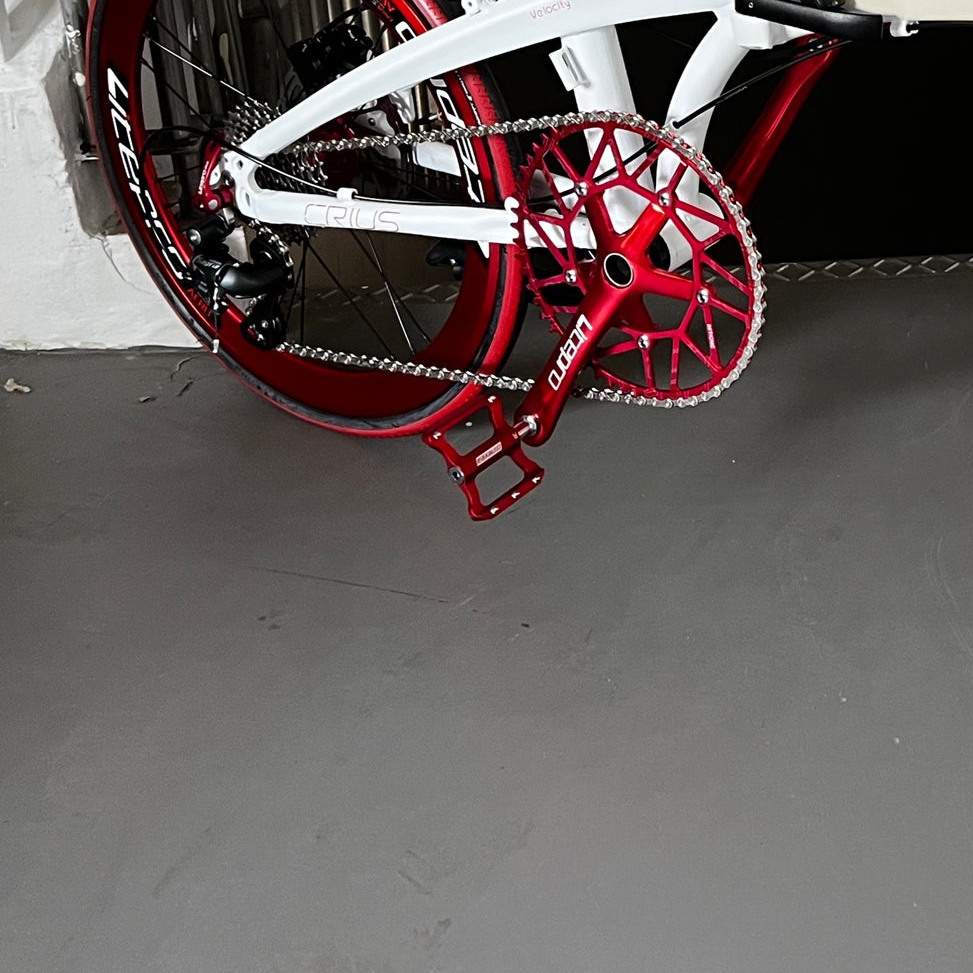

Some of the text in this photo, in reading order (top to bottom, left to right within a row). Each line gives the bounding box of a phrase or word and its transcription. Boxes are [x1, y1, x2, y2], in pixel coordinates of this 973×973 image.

[529, 0, 572, 20] Velocity
[303, 203, 401, 233] CRIUS
[547, 314, 593, 391] Litepro
